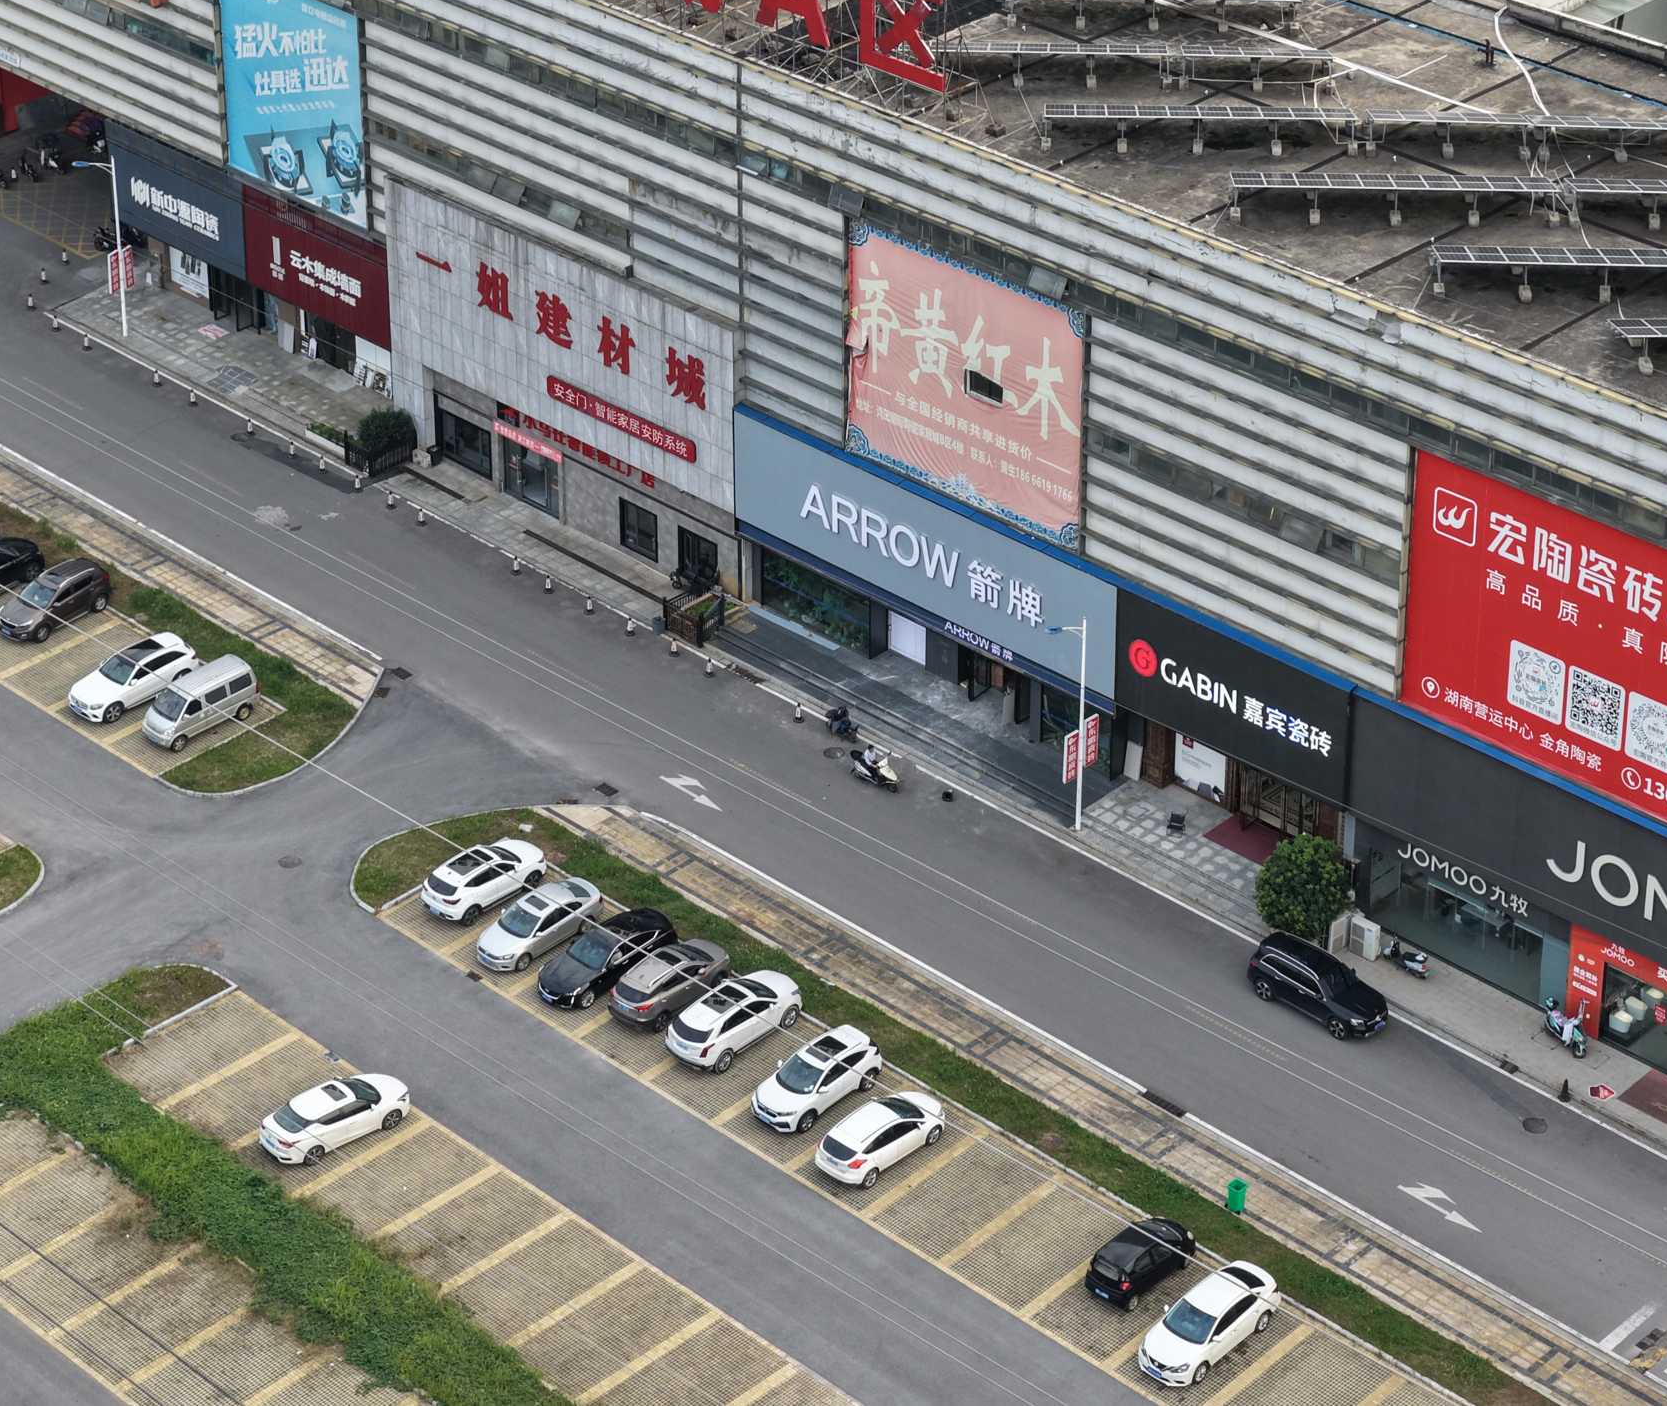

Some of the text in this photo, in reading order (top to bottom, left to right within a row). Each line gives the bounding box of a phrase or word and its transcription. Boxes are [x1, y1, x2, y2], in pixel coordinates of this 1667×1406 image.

[234, 21, 327, 60] 猛火不怕比
[254, 55, 350, 97] 灶具选迅达
[149, 187, 220, 235] 新中源陶瓷
[289, 249, 363, 299] 云木集成墙面
[415, 251, 707, 411] 一姐建材城
[553, 382, 688, 458] 安全门·智能家居安防系统
[894, 391, 1033, 463] 与全国经销商共享进货价
[799, 483, 1046, 628] ARROW 箭牌
[1486, 511, 1664, 622] 宏陶瓷砖
[943, 619, 1015, 662] ARROW 箭牌
[1160, 657, 1237, 714] GABIN
[1243, 695, 1334, 758] 嘉宾瓷砖
[1444, 688, 1534, 741] 湖南营运中心
[1539, 731, 1603, 772] 金角陶瓷
[1398, 843, 1529, 918] JOMOO 九牧
[1601, 947, 1635, 968] JOMOO
